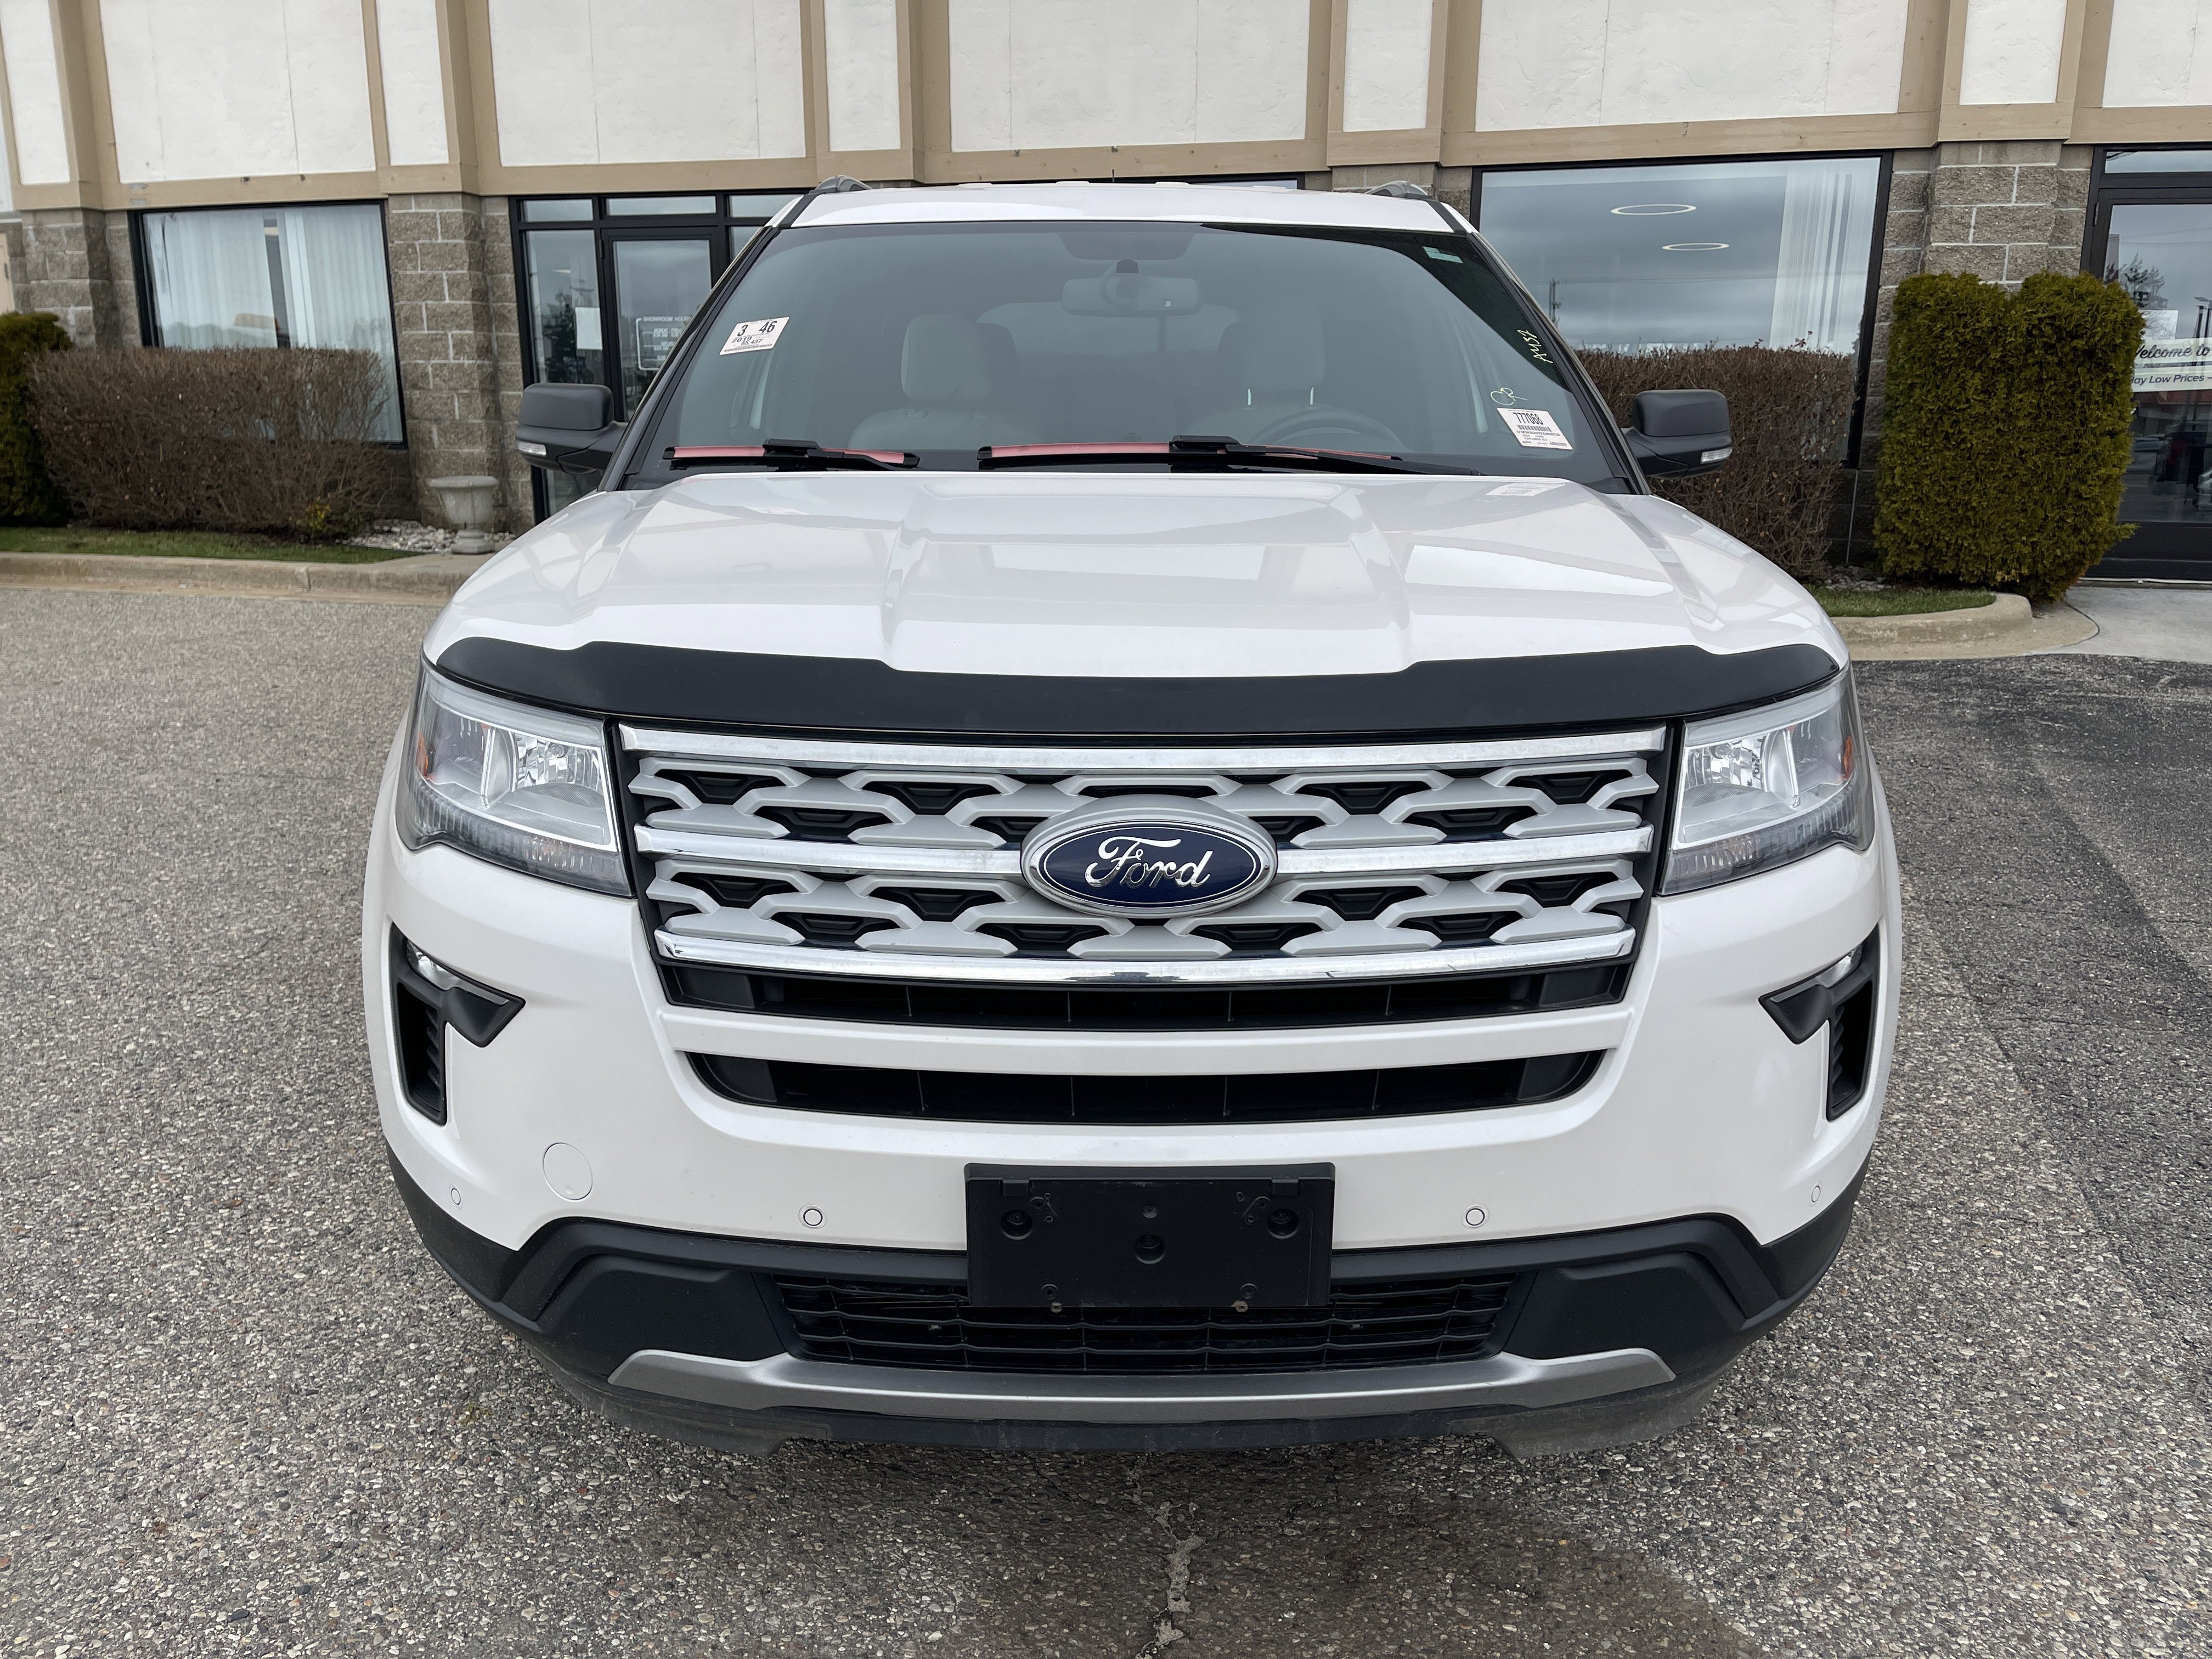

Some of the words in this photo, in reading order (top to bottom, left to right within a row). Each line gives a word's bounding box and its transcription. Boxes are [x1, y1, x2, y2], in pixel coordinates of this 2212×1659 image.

[737, 324, 748, 336] 3
[759, 320, 777, 334] 46
[2136, 345, 2192, 358] elcome
[2196, 343, 2210, 356] to
[2173, 374, 2204, 382] Prices
[1513, 412, 1544, 425] 777068
[1085, 836, 1213, 888] Ford
